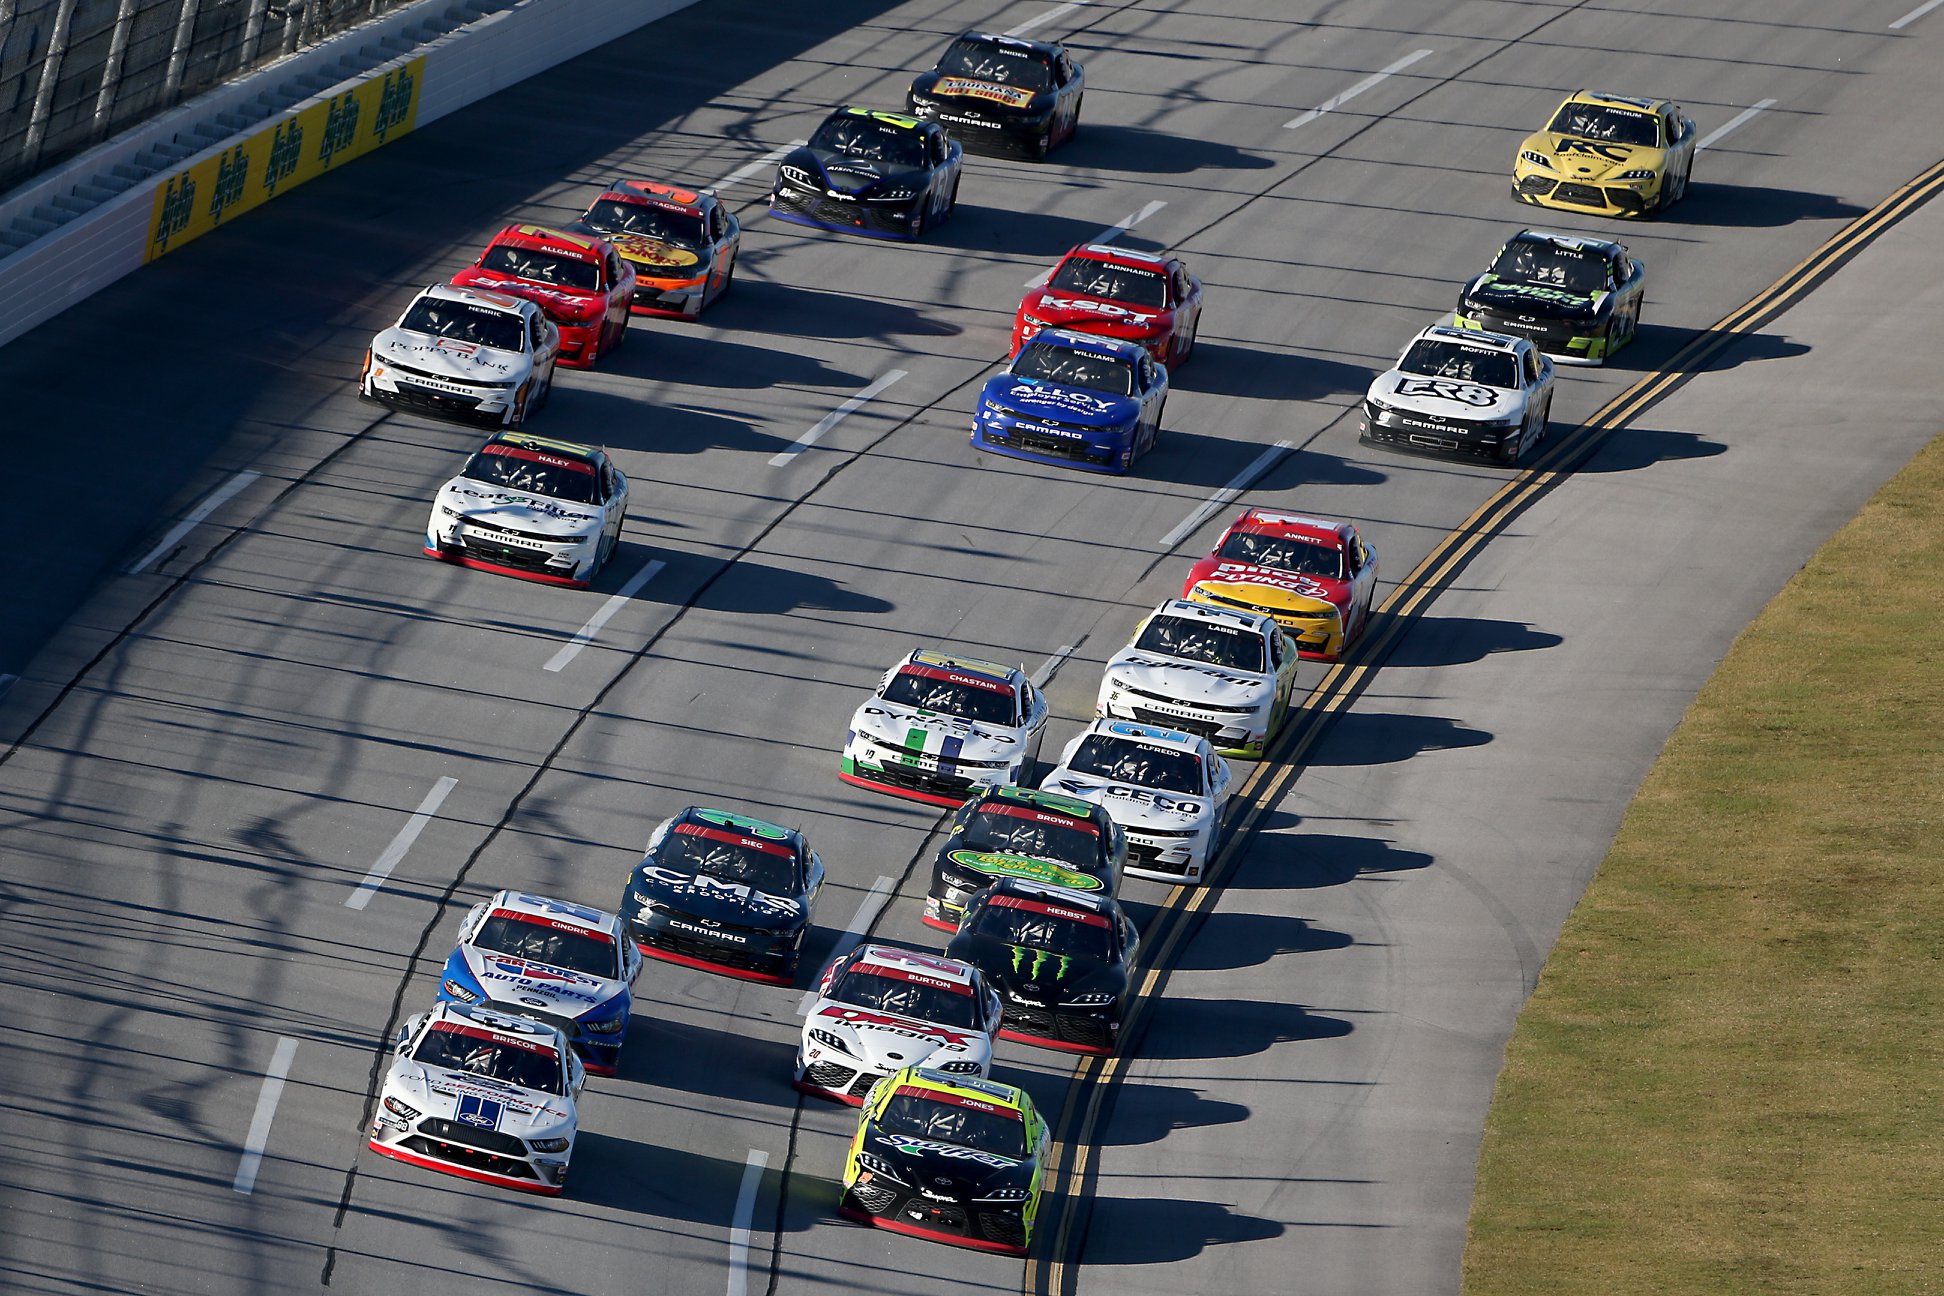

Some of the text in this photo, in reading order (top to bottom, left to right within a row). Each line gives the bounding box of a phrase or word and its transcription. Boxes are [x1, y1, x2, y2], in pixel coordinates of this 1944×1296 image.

[999, 48, 1028, 59] SNIDER
[1605, 107, 1642, 118] FINCHUM
[939, 113, 1002, 130] CAMARO
[879, 126, 898, 135] HILL
[540, 244, 583, 259] ALLGAIER
[1555, 249, 1584, 259] LITTLE
[1102, 262, 1156, 278] EARNHARDT
[468, 305, 502, 318] HEMRIC
[1040, 294, 1157, 322] KSDT
[1503, 321, 1548, 332] CAMARO
[389, 341, 510, 373] POPPY BANK
[1073, 349, 1116, 363] WILLIAMS
[1460, 345, 1499, 357] MOFFITT
[405, 376, 473, 395] CAMARO
[1009, 390, 1108, 413] Employer Services
[1011, 385, 1117, 409] ALLOY
[1057, 402, 1067, 410] by
[1068, 404, 1094, 416] design
[1015, 421, 1083, 440] CAMARO
[1402, 418, 1469, 435] CAMARO
[538, 454, 570, 467] HALEY
[473, 529, 544, 549] CAMARO
[1284, 532, 1323, 545] ANNETT
[1209, 571, 1297, 589] FLYING
[1208, 624, 1239, 636] LABBE
[949, 673, 997, 690] CHASTAIN
[1144, 702, 1215, 721] CAMARO
[1136, 743, 1181, 757] ALFREDO
[891, 754, 965, 775] CAMARO
[1106, 785, 1202, 815] CECO
[1036, 813, 1074, 827] BROWN
[741, 838, 763, 849] SIEG
[642, 866, 801, 916] CMR
[1046, 906, 1087, 921] HERBST
[551, 921, 589, 936] CINDRIC
[669, 919, 746, 944] CAMARO
[485, 954, 602, 988] CARQUEST
[480, 971, 599, 1004] AUTO PARTS
[908, 973, 951, 989] BURTON
[516, 984, 557, 999] PENNZOIL
[1010, 991, 1046, 1008] Supra
[492, 1033, 537, 1051] BRISCOE
[808, 1048, 821, 1059] 20
[399, 1073, 568, 1119] FORD PERFORMANCE
[429, 1084, 529, 1112] RACING SCHOOL
[960, 1098, 995, 1111] JONES
[396, 1120, 408, 1131] 98
[920, 1186, 958, 1203] Supra
